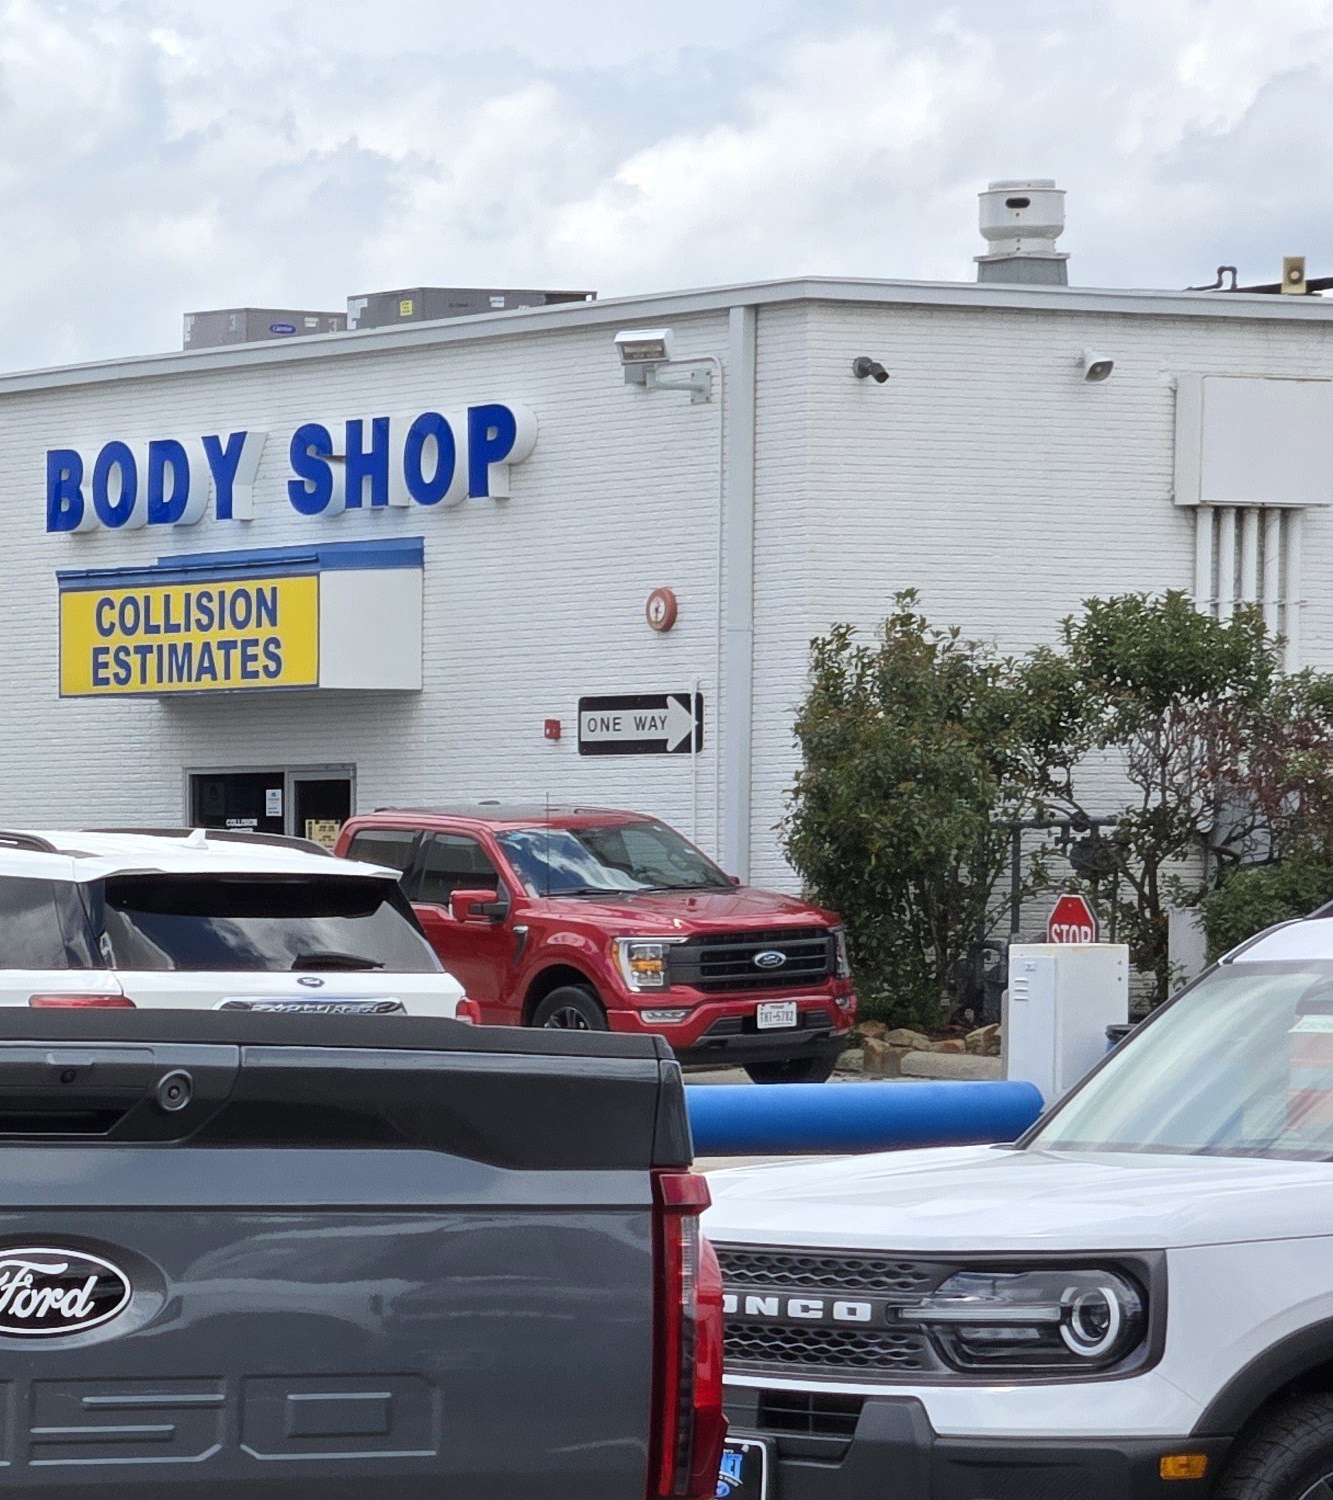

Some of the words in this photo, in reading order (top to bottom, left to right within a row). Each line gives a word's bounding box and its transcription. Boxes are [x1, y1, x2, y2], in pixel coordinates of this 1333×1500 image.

[45, 430, 249, 534] BODY
[287, 403, 521, 517] SHOP
[94, 586, 279, 638] COLLISION
[91, 636, 283, 688] ESTIMATES
[587, 717, 623, 733] ONE
[634, 715, 668, 731] WAY
[1051, 923, 1092, 944] STOP
